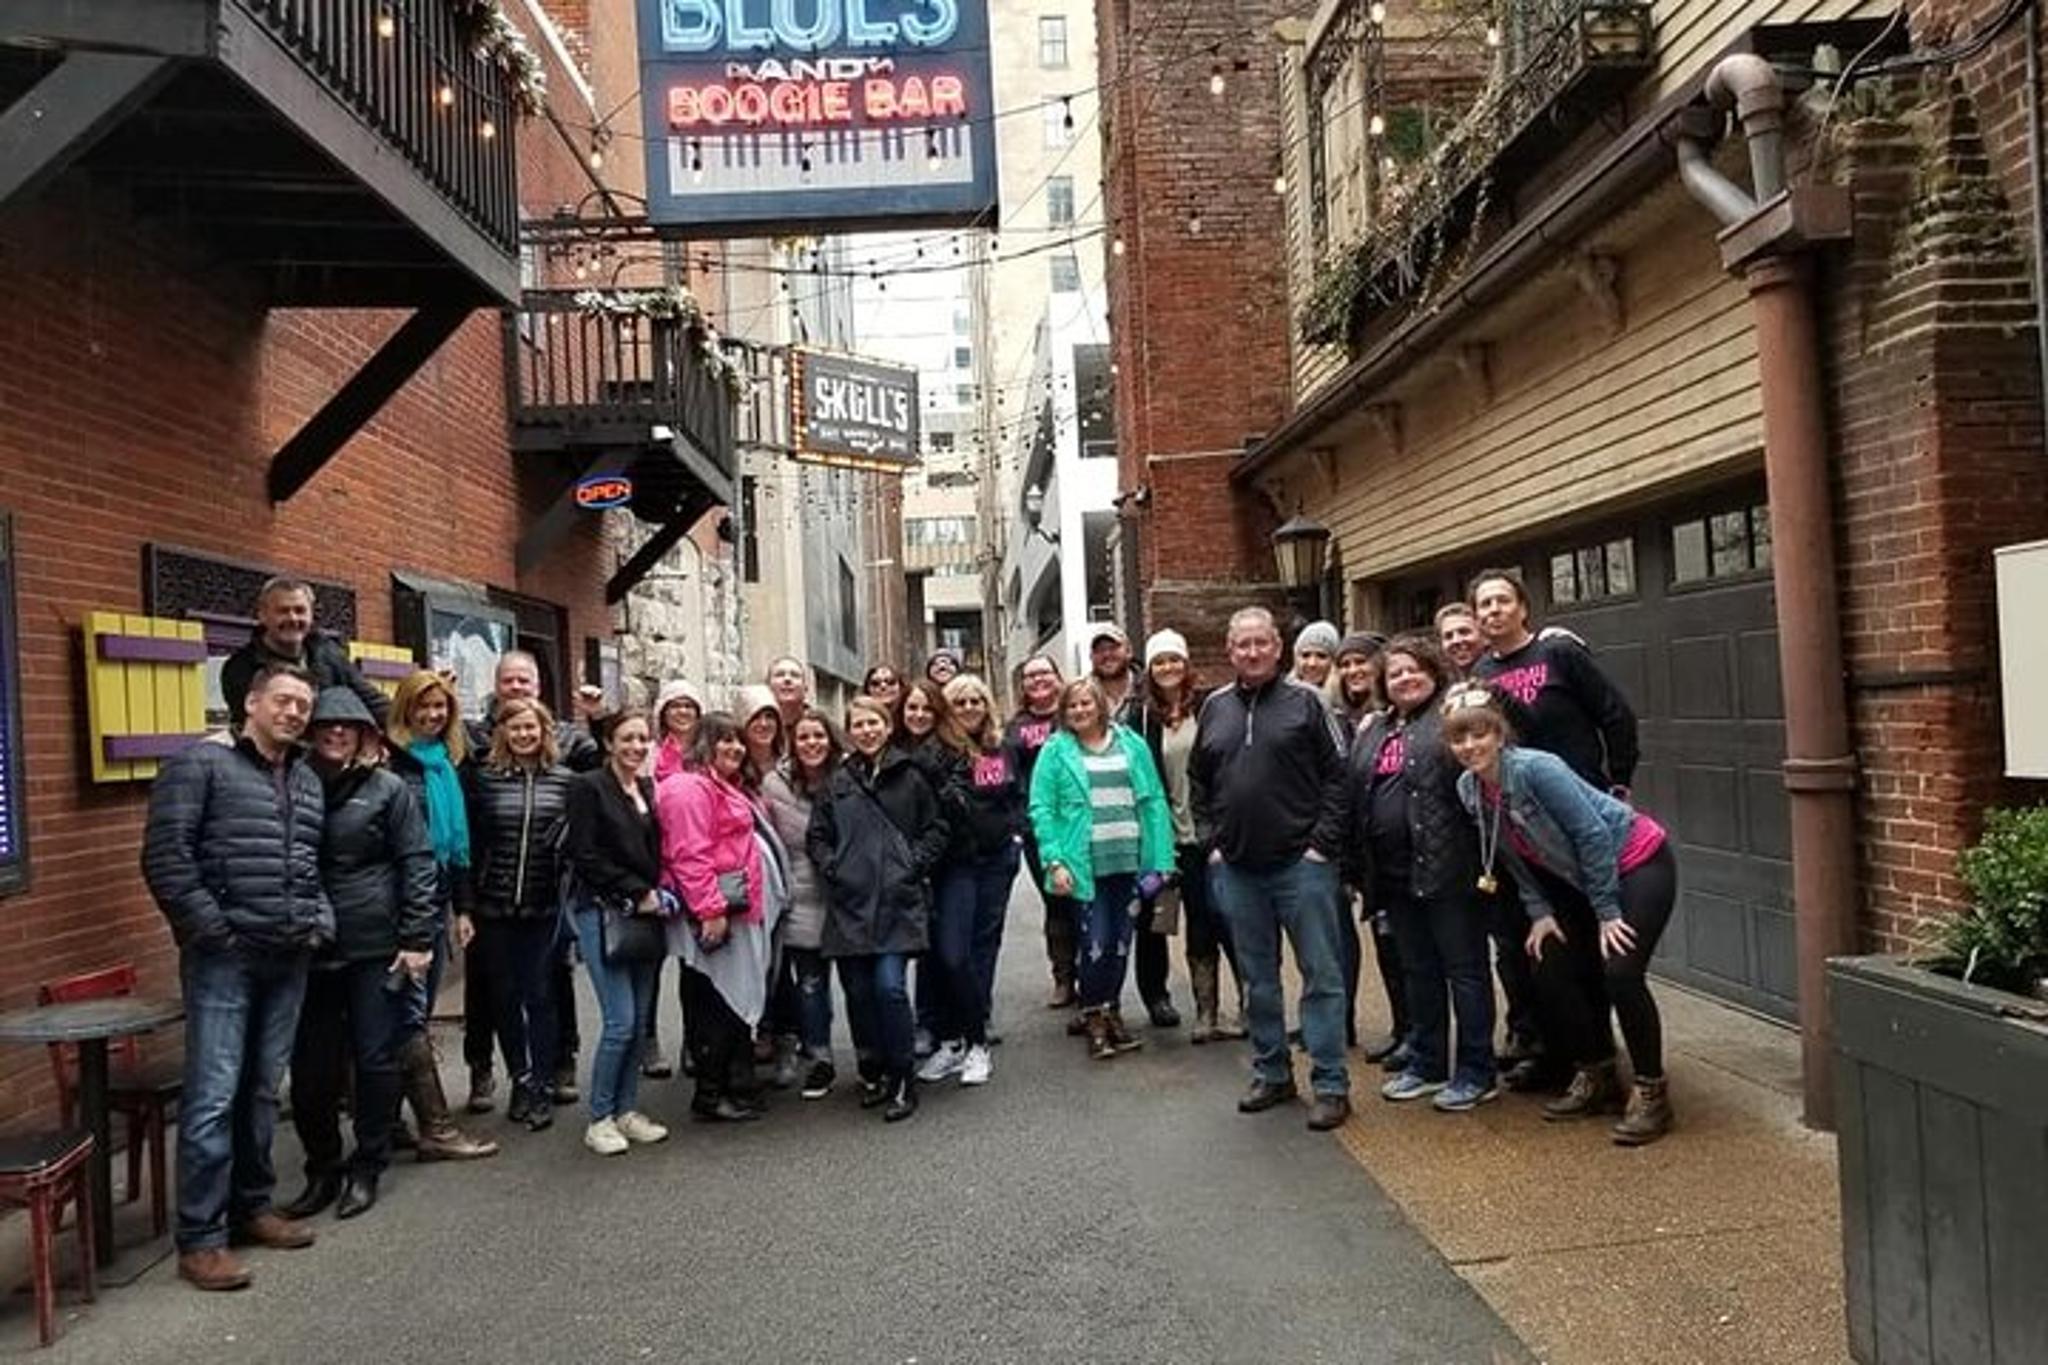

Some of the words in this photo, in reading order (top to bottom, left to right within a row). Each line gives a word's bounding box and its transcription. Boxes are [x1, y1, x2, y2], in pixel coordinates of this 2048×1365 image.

[756, 59, 866, 81] AND
[668, 83, 851, 124] BOOGIE
[865, 76, 966, 118] BAR
[577, 484, 630, 501] OPEN
